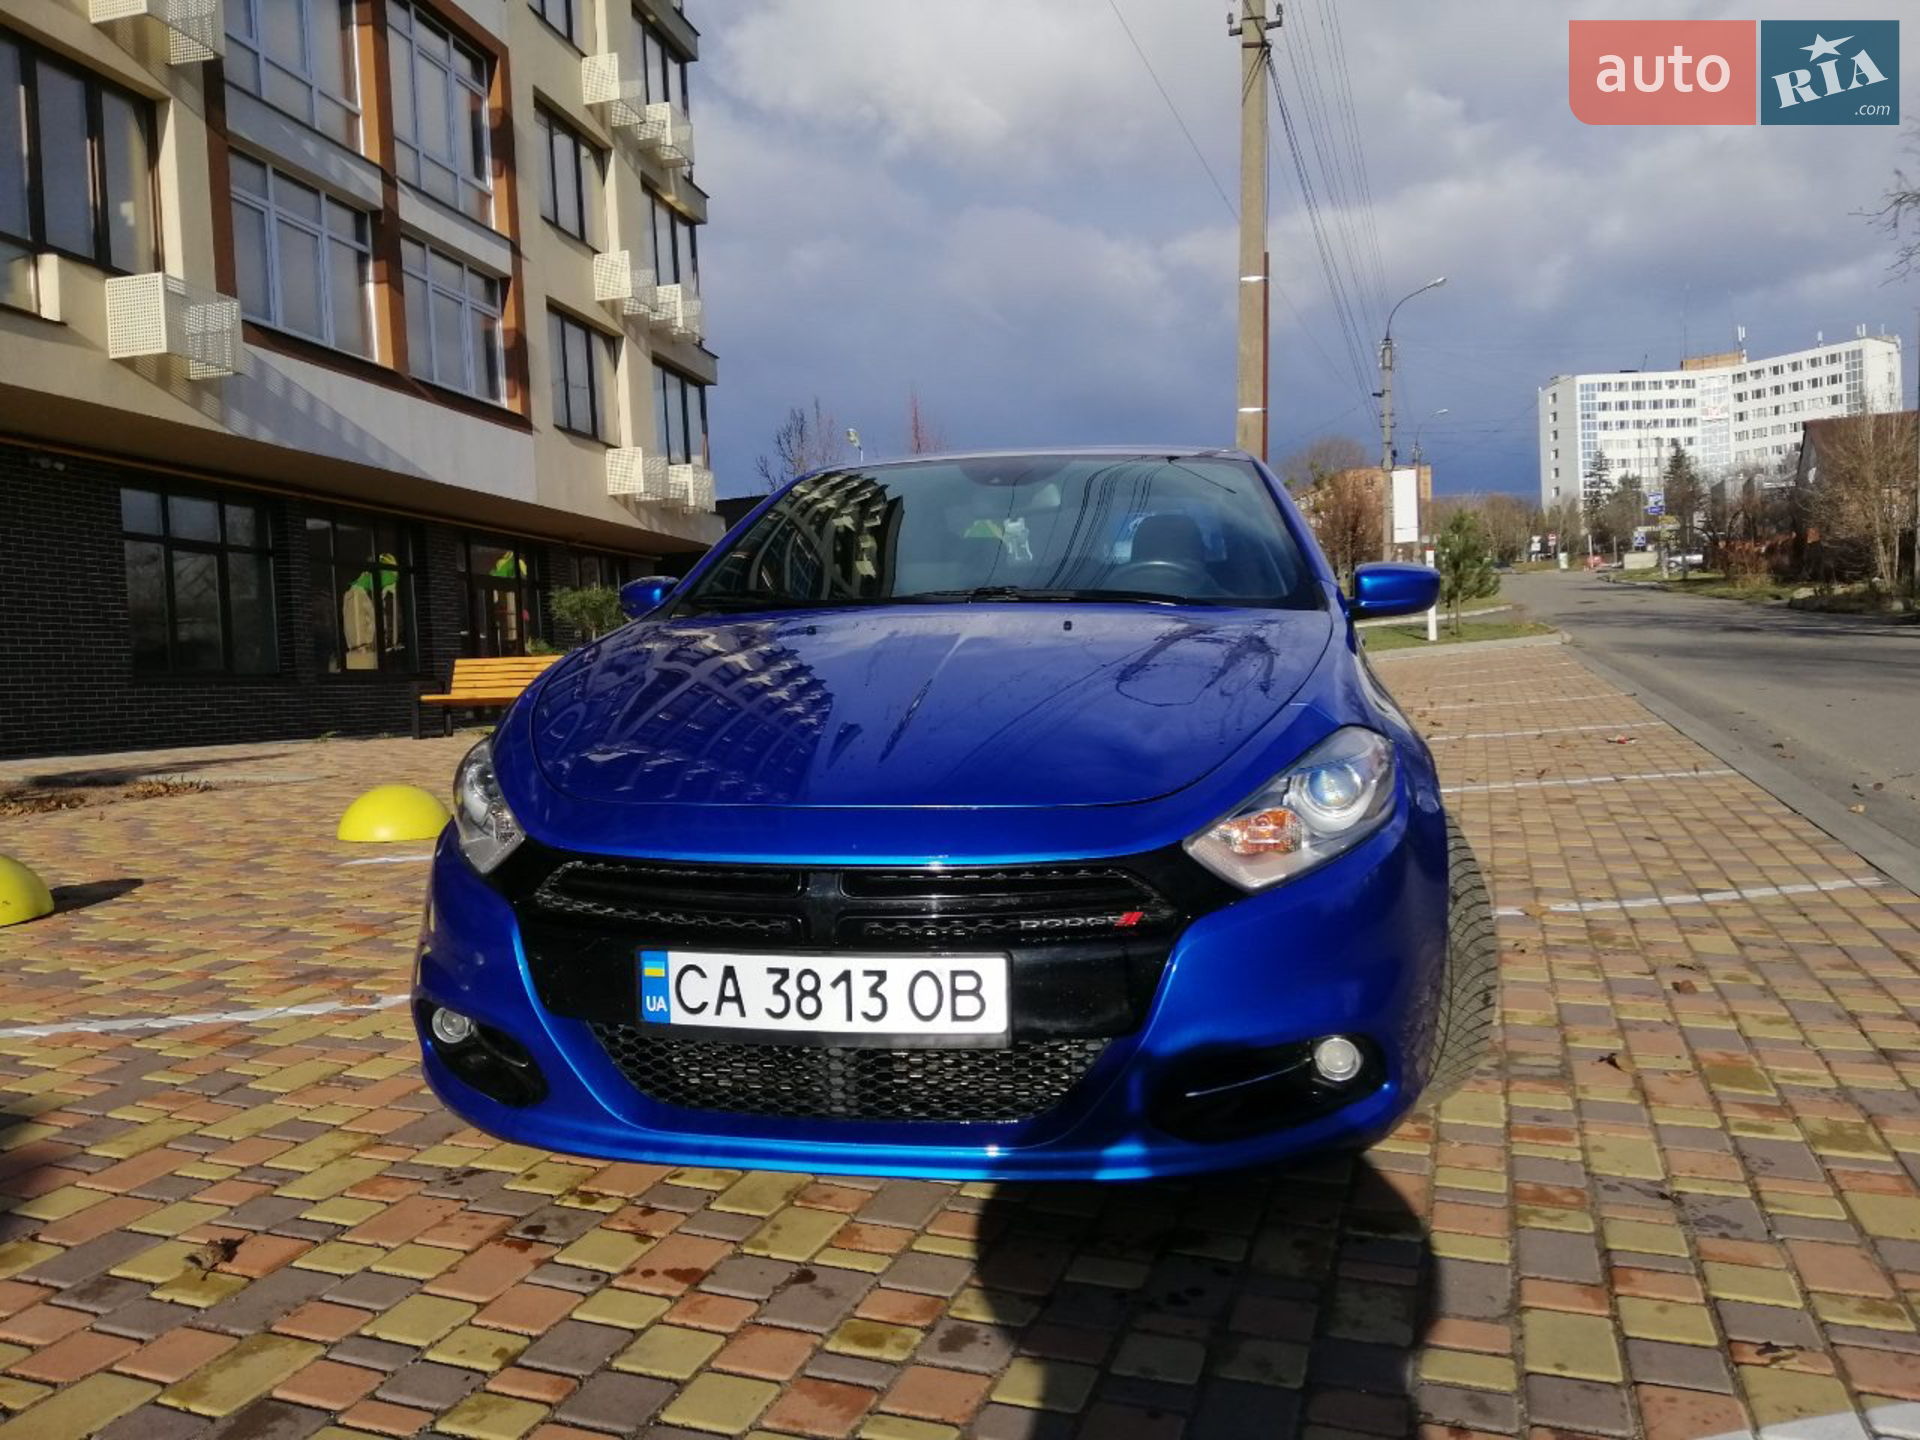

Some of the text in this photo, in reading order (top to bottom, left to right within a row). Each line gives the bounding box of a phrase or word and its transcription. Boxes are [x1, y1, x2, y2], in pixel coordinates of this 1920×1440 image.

[646, 995, 668, 1012] UA
[674, 964, 987, 1022] CA 3813 OB
